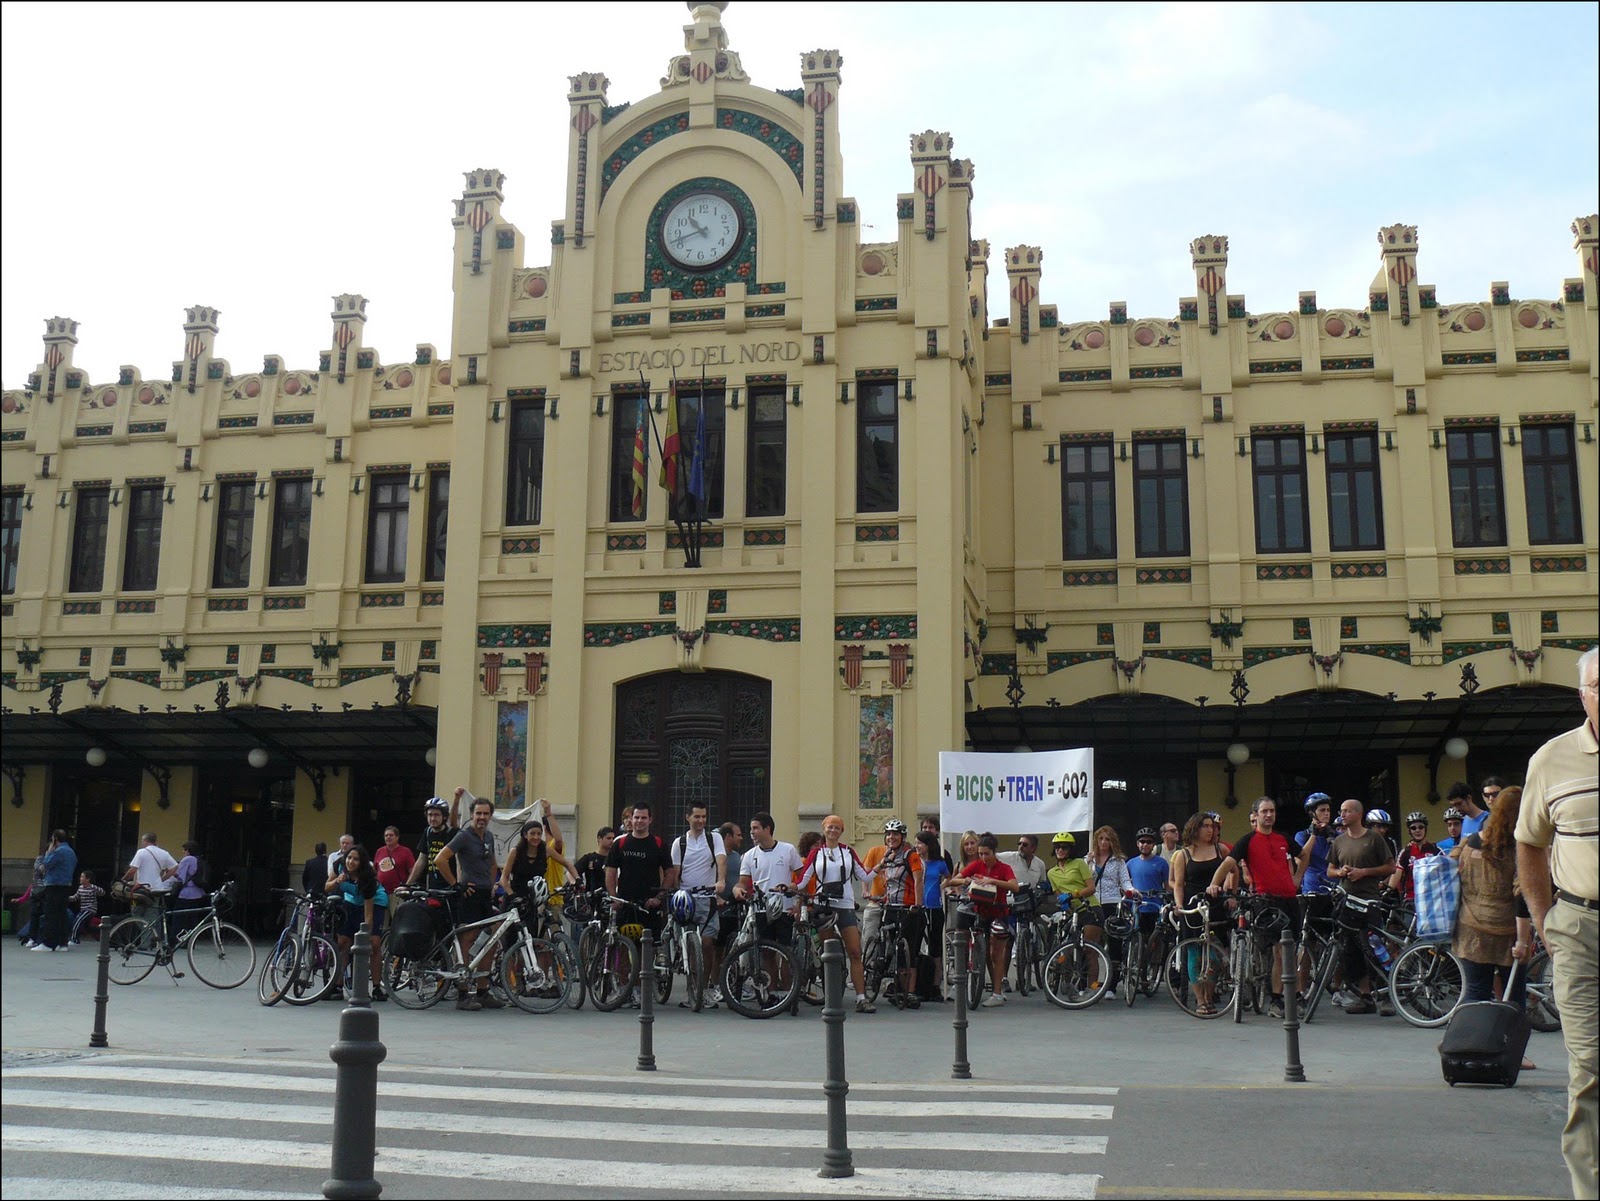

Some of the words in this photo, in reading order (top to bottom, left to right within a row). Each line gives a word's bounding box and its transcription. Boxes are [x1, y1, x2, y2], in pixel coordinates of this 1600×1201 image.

[699, 204, 709, 214] 12
[713, 207, 717, 216] 1
[677, 218, 688, 227] 10
[721, 214, 727, 223] 2
[674, 229, 682, 238] 9
[723, 226, 730, 235] 3
[676, 239, 684, 249] 8
[717, 238, 725, 247] 4
[685, 249, 692, 258] 7
[697, 251, 704, 260] 6
[710, 248, 717, 257] 5
[598, 344, 684, 373] ESTACIÓ
[691, 345, 735, 367] DEL
[739, 341, 801, 364] NORD
[956, 775, 994, 802] BICIS
[622, 850, 646, 859] VIVARIS
